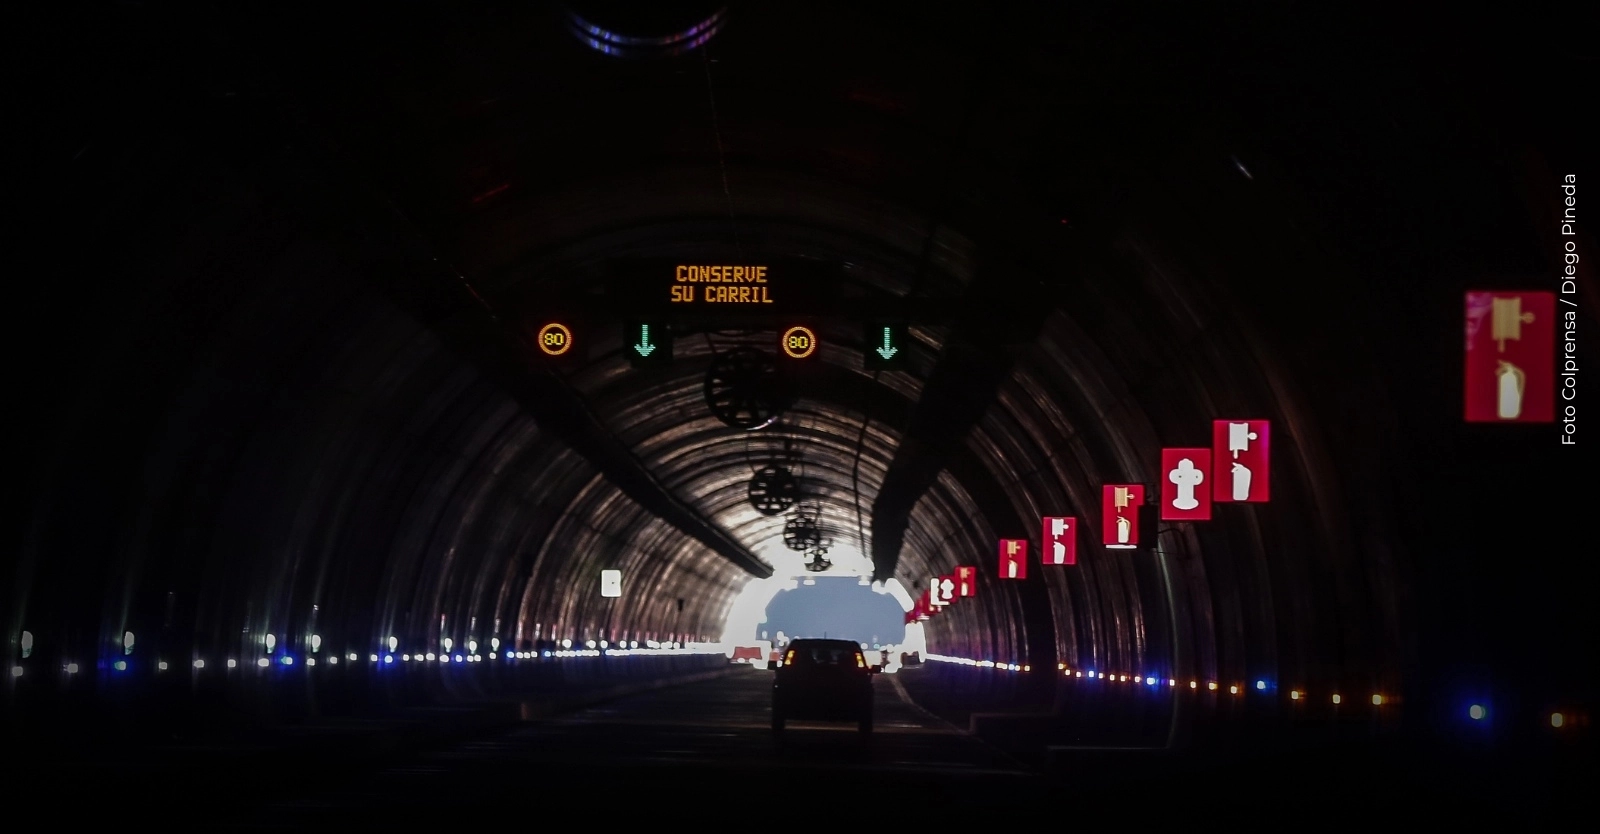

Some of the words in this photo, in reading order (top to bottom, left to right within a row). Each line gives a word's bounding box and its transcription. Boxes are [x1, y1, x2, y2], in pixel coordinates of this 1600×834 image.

[676, 265, 768, 283] CONSERVE
[671, 285, 694, 303] SU
[705, 285, 773, 304] CARRIL
[544, 333, 565, 346] 80
[788, 336, 809, 349] 80
